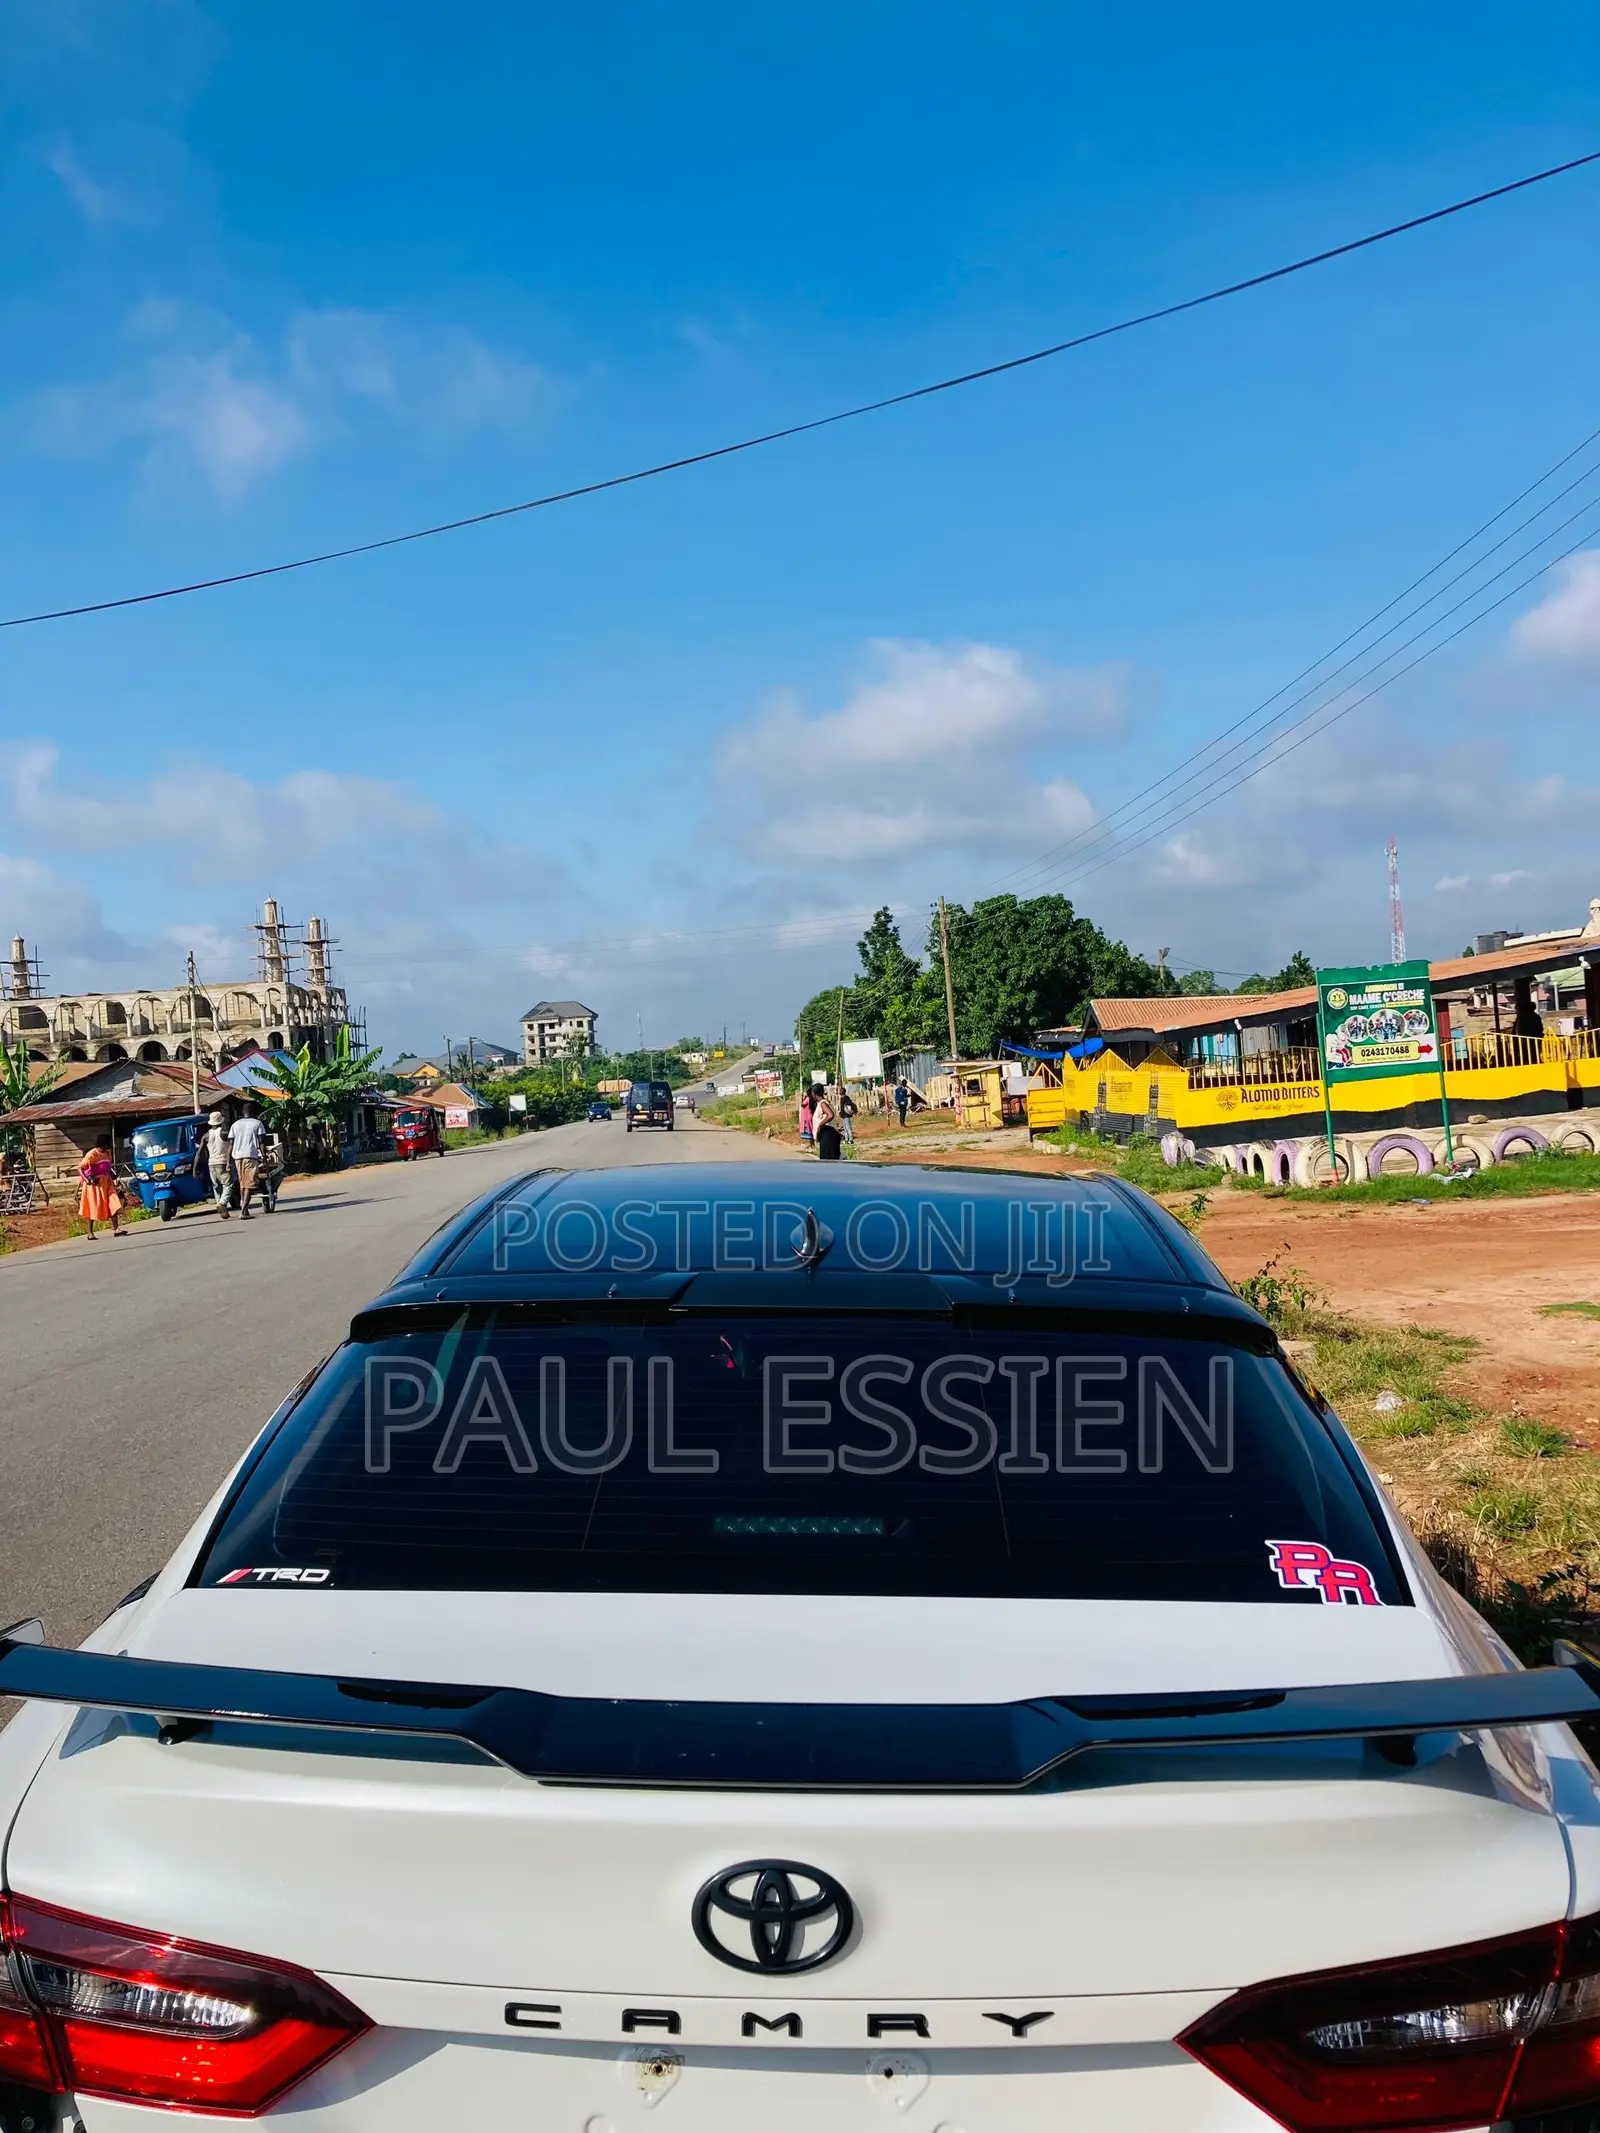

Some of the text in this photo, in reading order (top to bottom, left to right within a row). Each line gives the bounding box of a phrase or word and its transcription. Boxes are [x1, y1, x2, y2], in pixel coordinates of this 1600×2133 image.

[1349, 992, 1382, 1005] MAAME
[1361, 1046, 1410, 1057] 0243170488
[1282, 1086, 1320, 1100] BITTERS
[252, 1567, 330, 1582] TRD
[504, 2002, 1055, 2038] CAMRY
